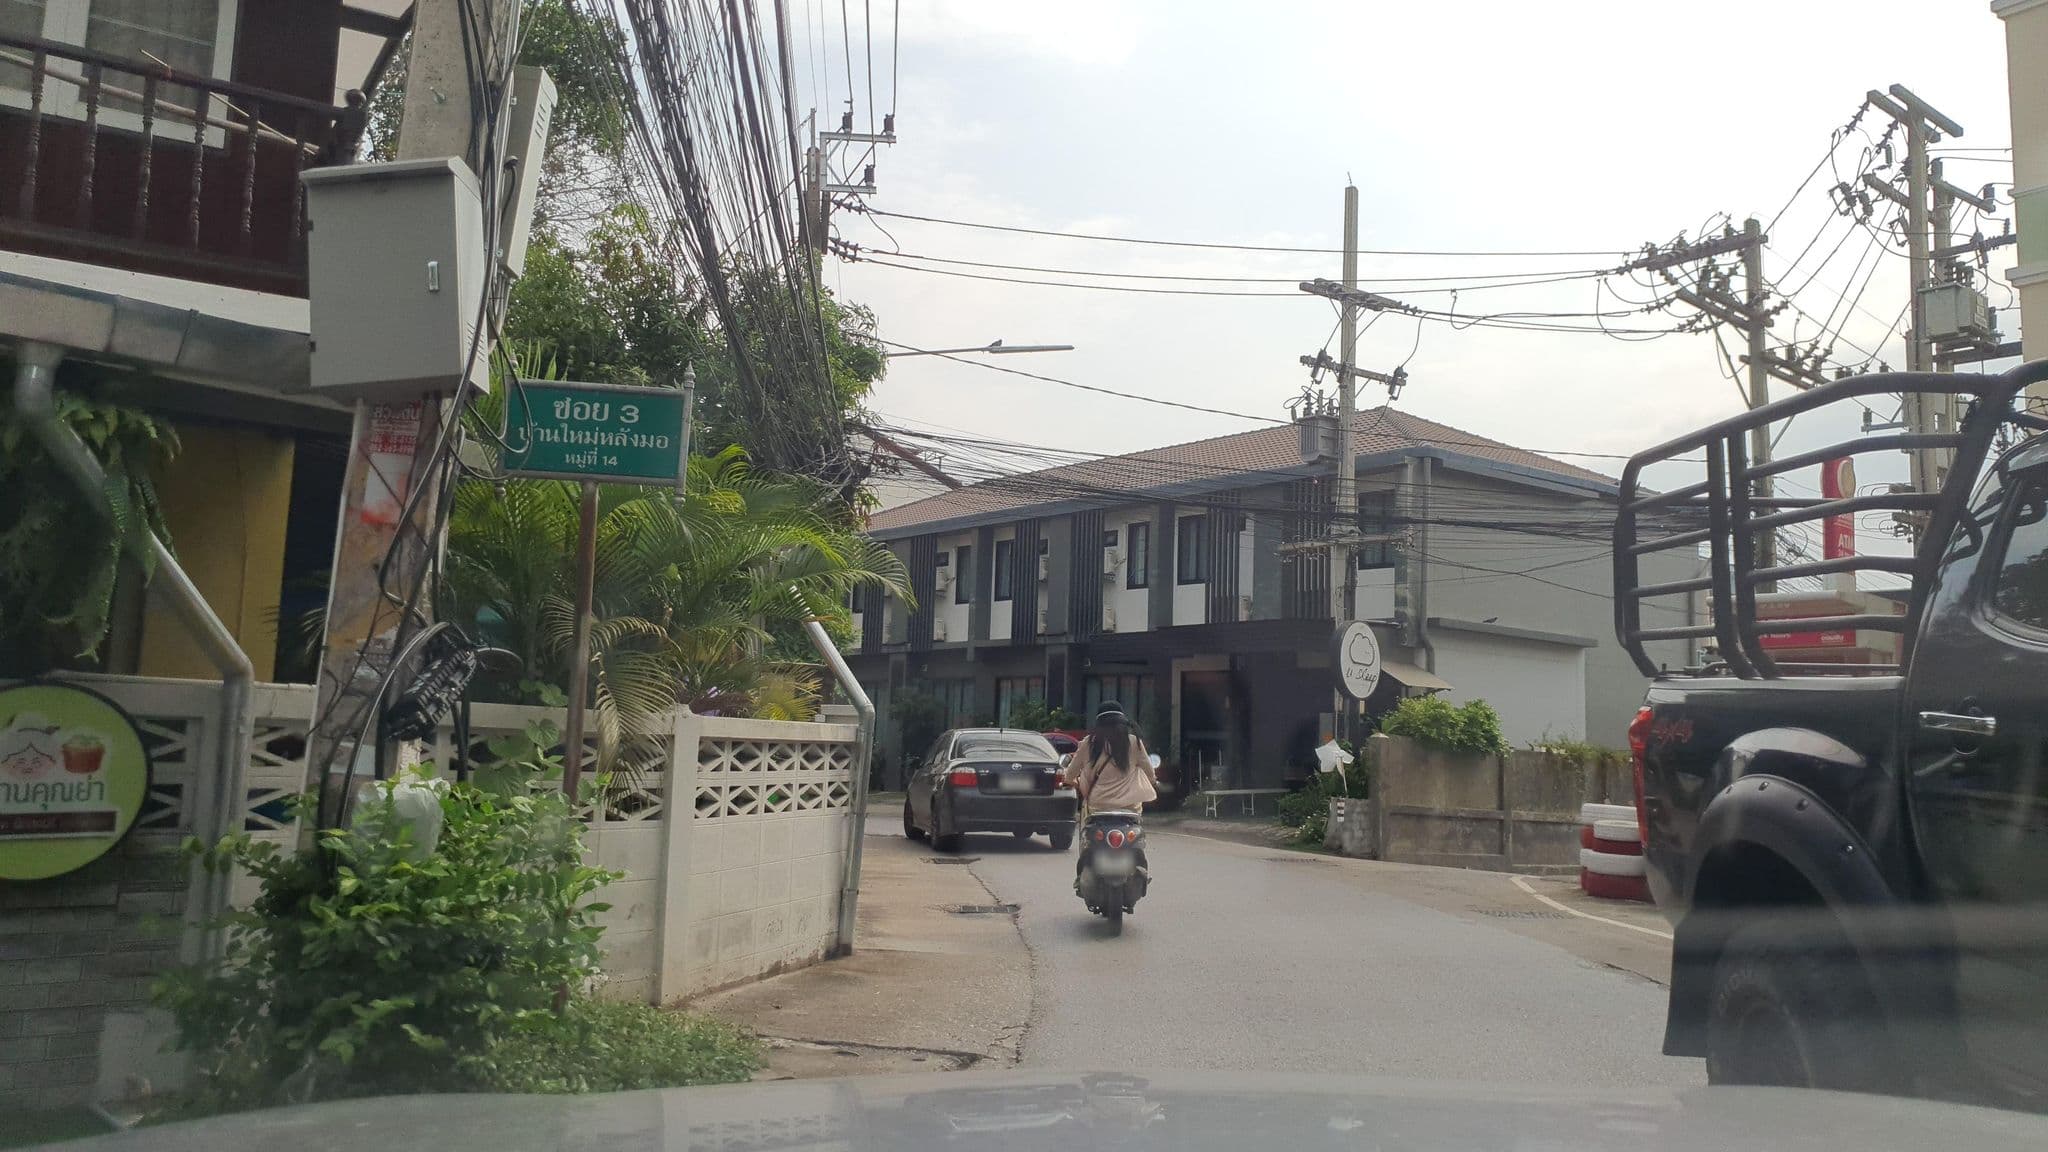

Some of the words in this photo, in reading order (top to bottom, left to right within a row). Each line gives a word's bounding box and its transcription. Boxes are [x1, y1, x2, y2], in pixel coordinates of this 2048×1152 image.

[553, 397, 609, 422] ซอย
[620, 404, 640, 423] 3
[565, 448, 598, 469] หมู่ที่
[603, 455, 618, 466] 14
